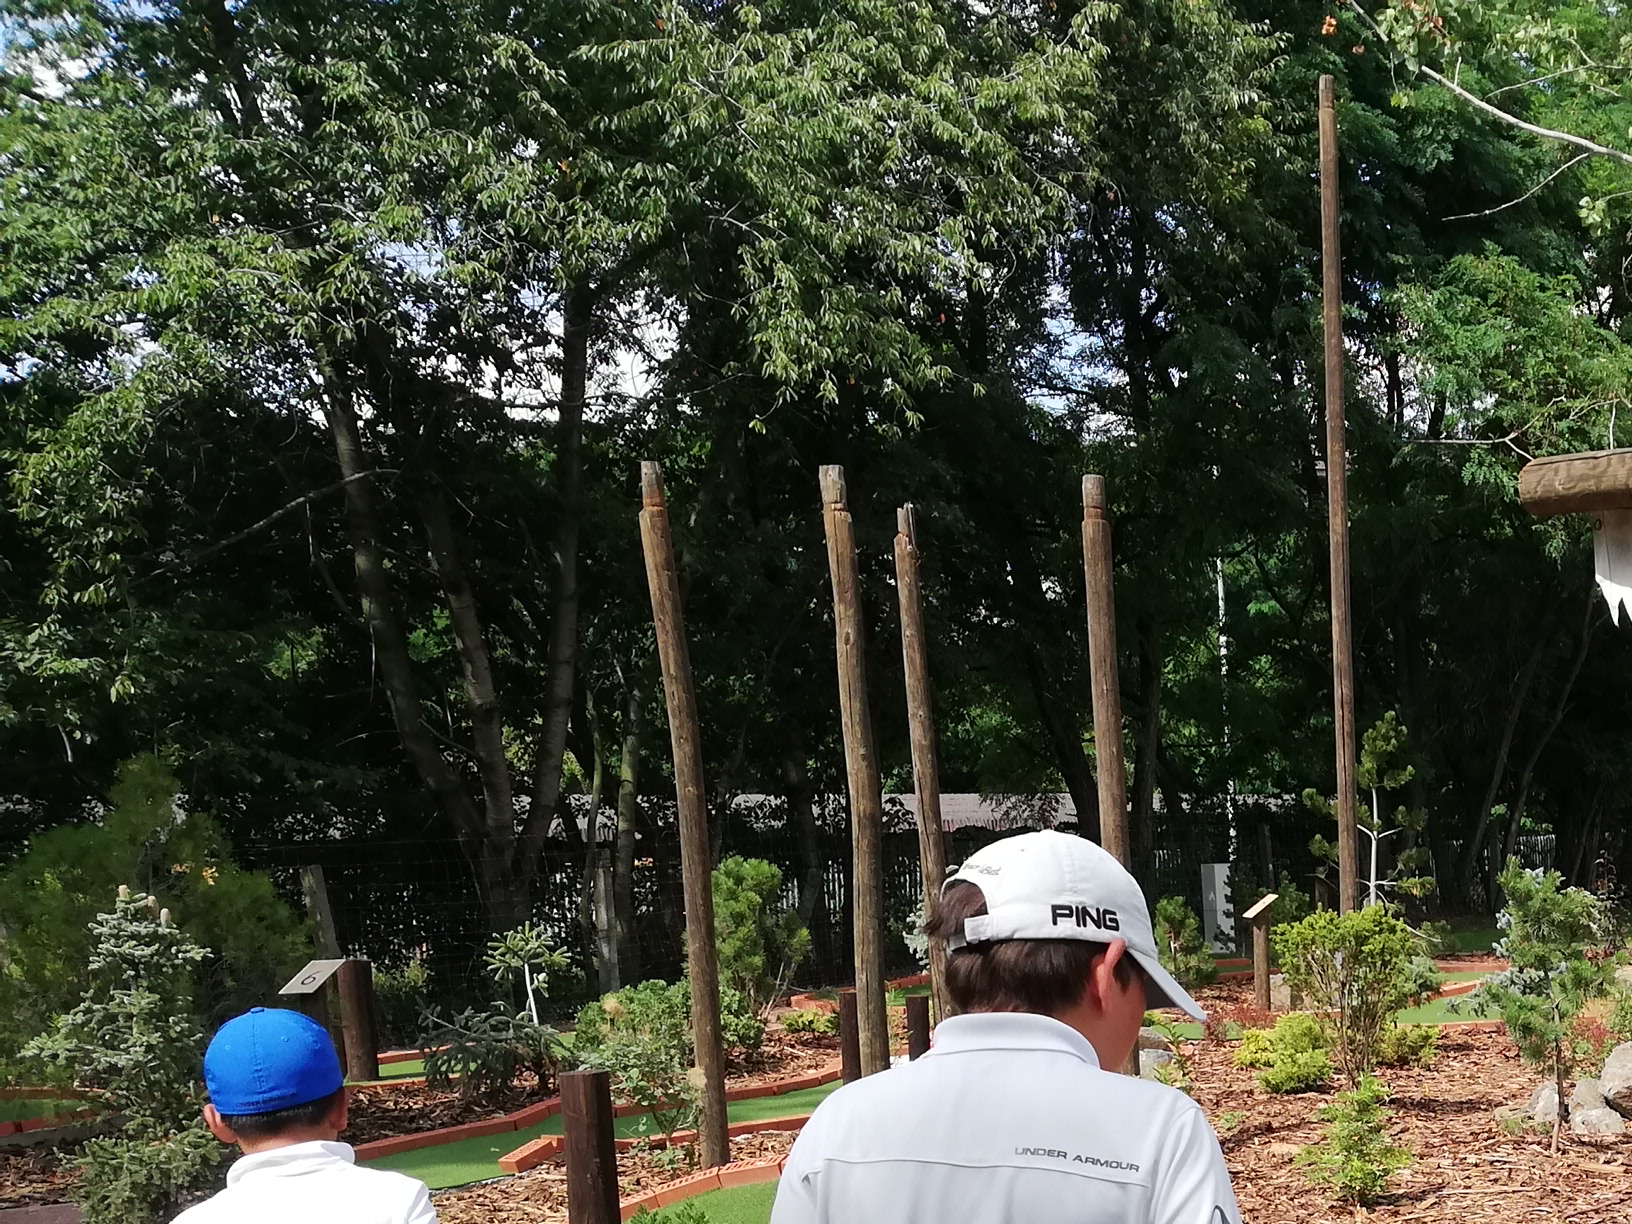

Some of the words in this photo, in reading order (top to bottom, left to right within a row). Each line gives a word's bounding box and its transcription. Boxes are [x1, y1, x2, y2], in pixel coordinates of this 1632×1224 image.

[1051, 904, 1120, 932] PING
[301, 970, 322, 986] 6
[1015, 1147, 1068, 1159] UNDER
[1072, 1154, 1140, 1172] ARMOUR
